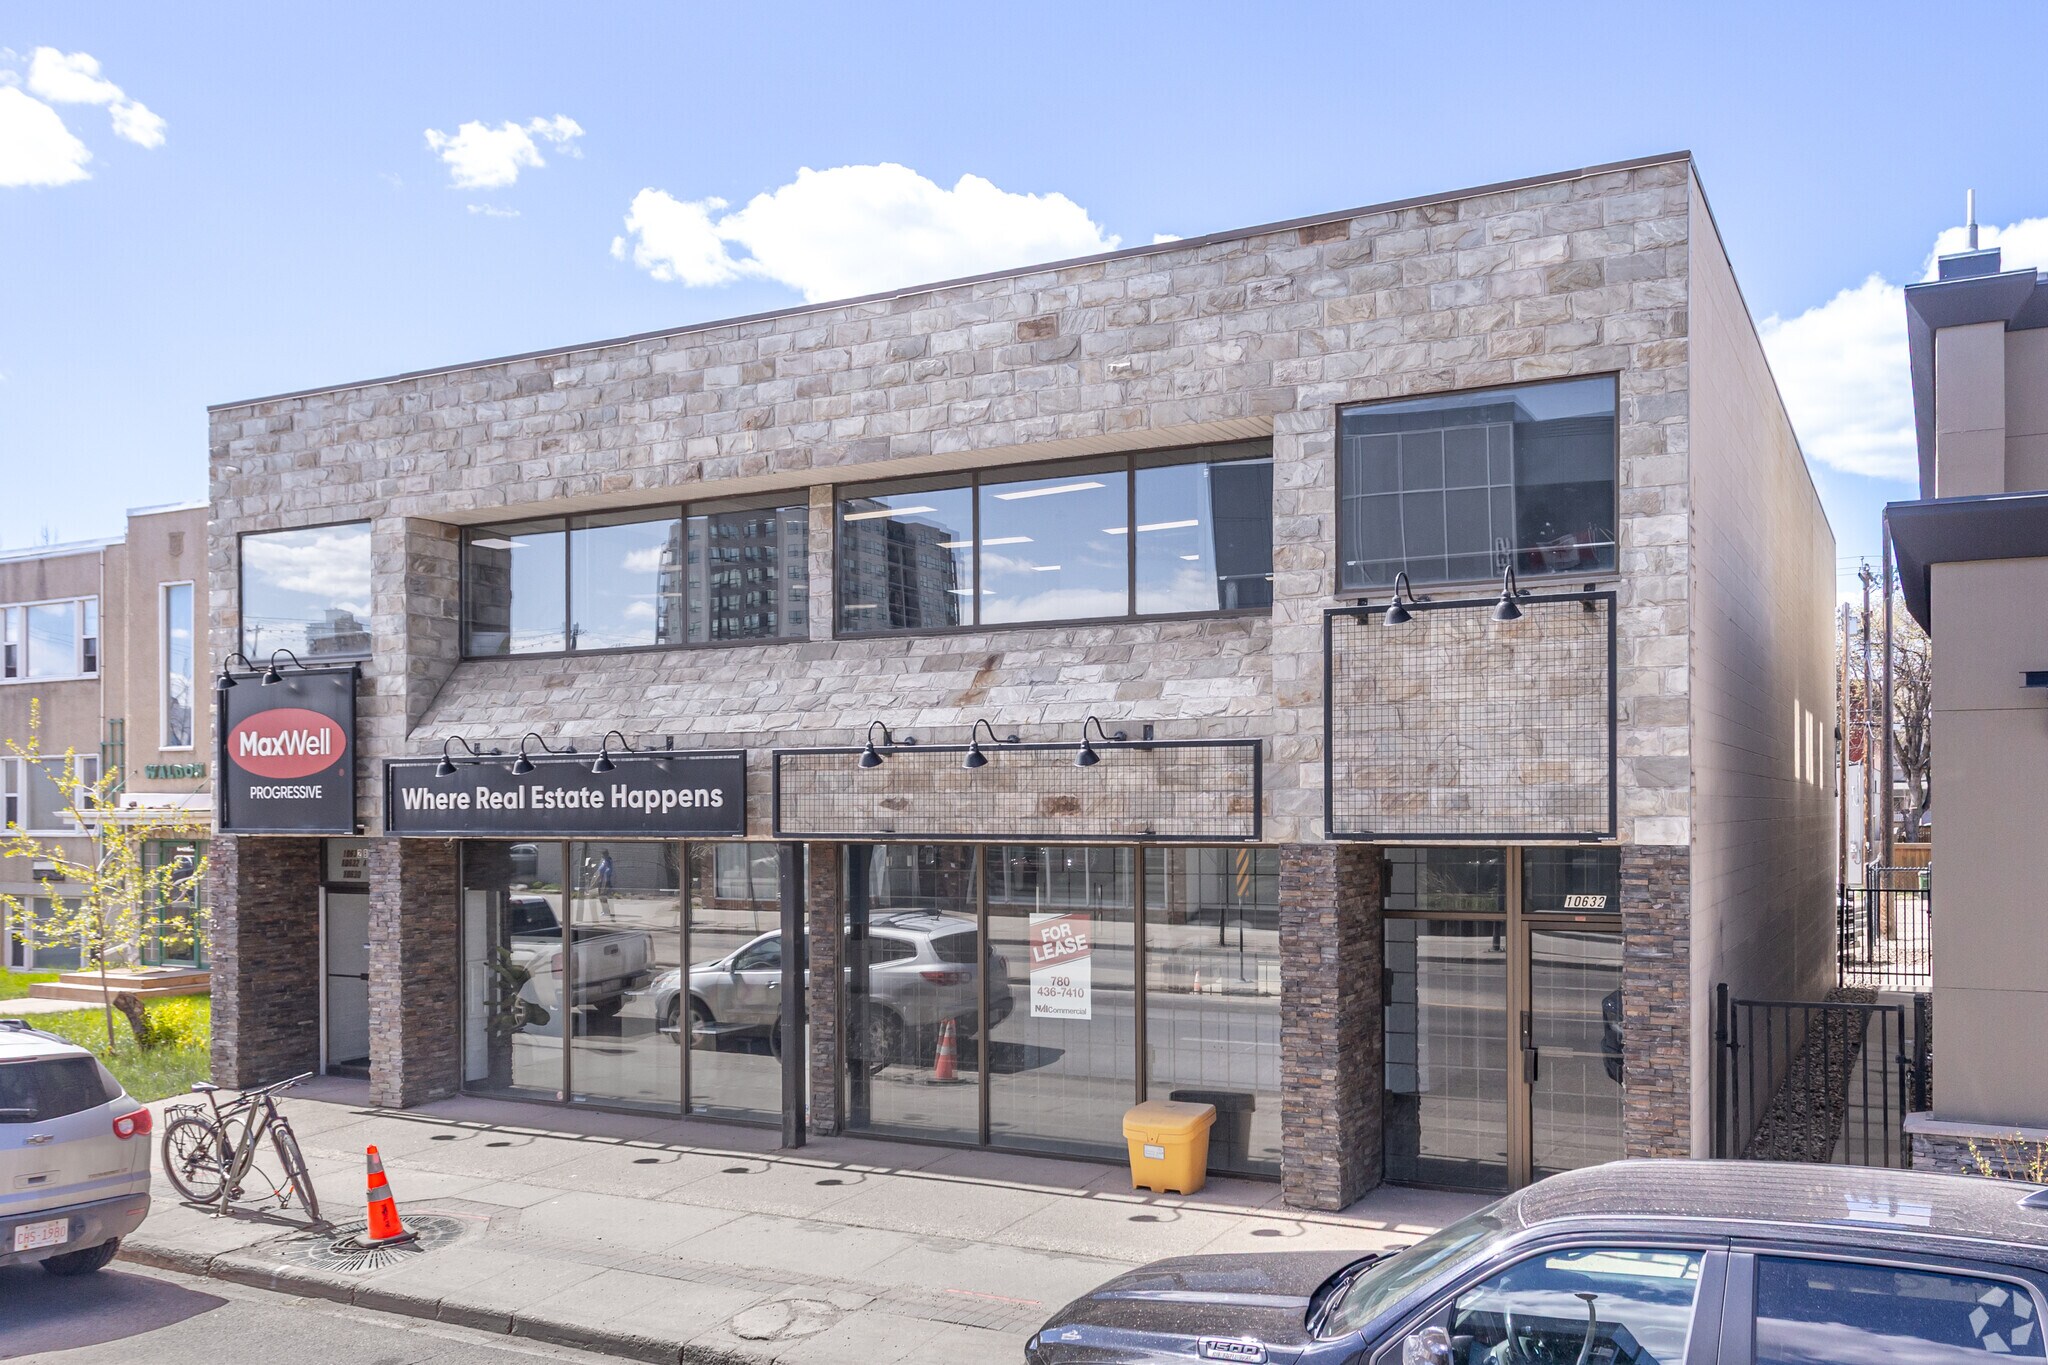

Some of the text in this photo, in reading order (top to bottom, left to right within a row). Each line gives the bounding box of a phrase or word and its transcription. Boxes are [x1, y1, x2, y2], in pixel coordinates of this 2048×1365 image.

[239, 728, 331, 757] MaxWell
[250, 785, 322, 799] PROGRESSIVE
[402, 784, 724, 814] Where Real Estate Happens
[1567, 896, 1605, 907] 10632
[1041, 923, 1072, 942] FOR
[1033, 934, 1088, 962] LEASE
[1050, 976, 1070, 986] 780
[1037, 987, 1084, 998] 436-7410
[1208, 1341, 1258, 1355] 1500
